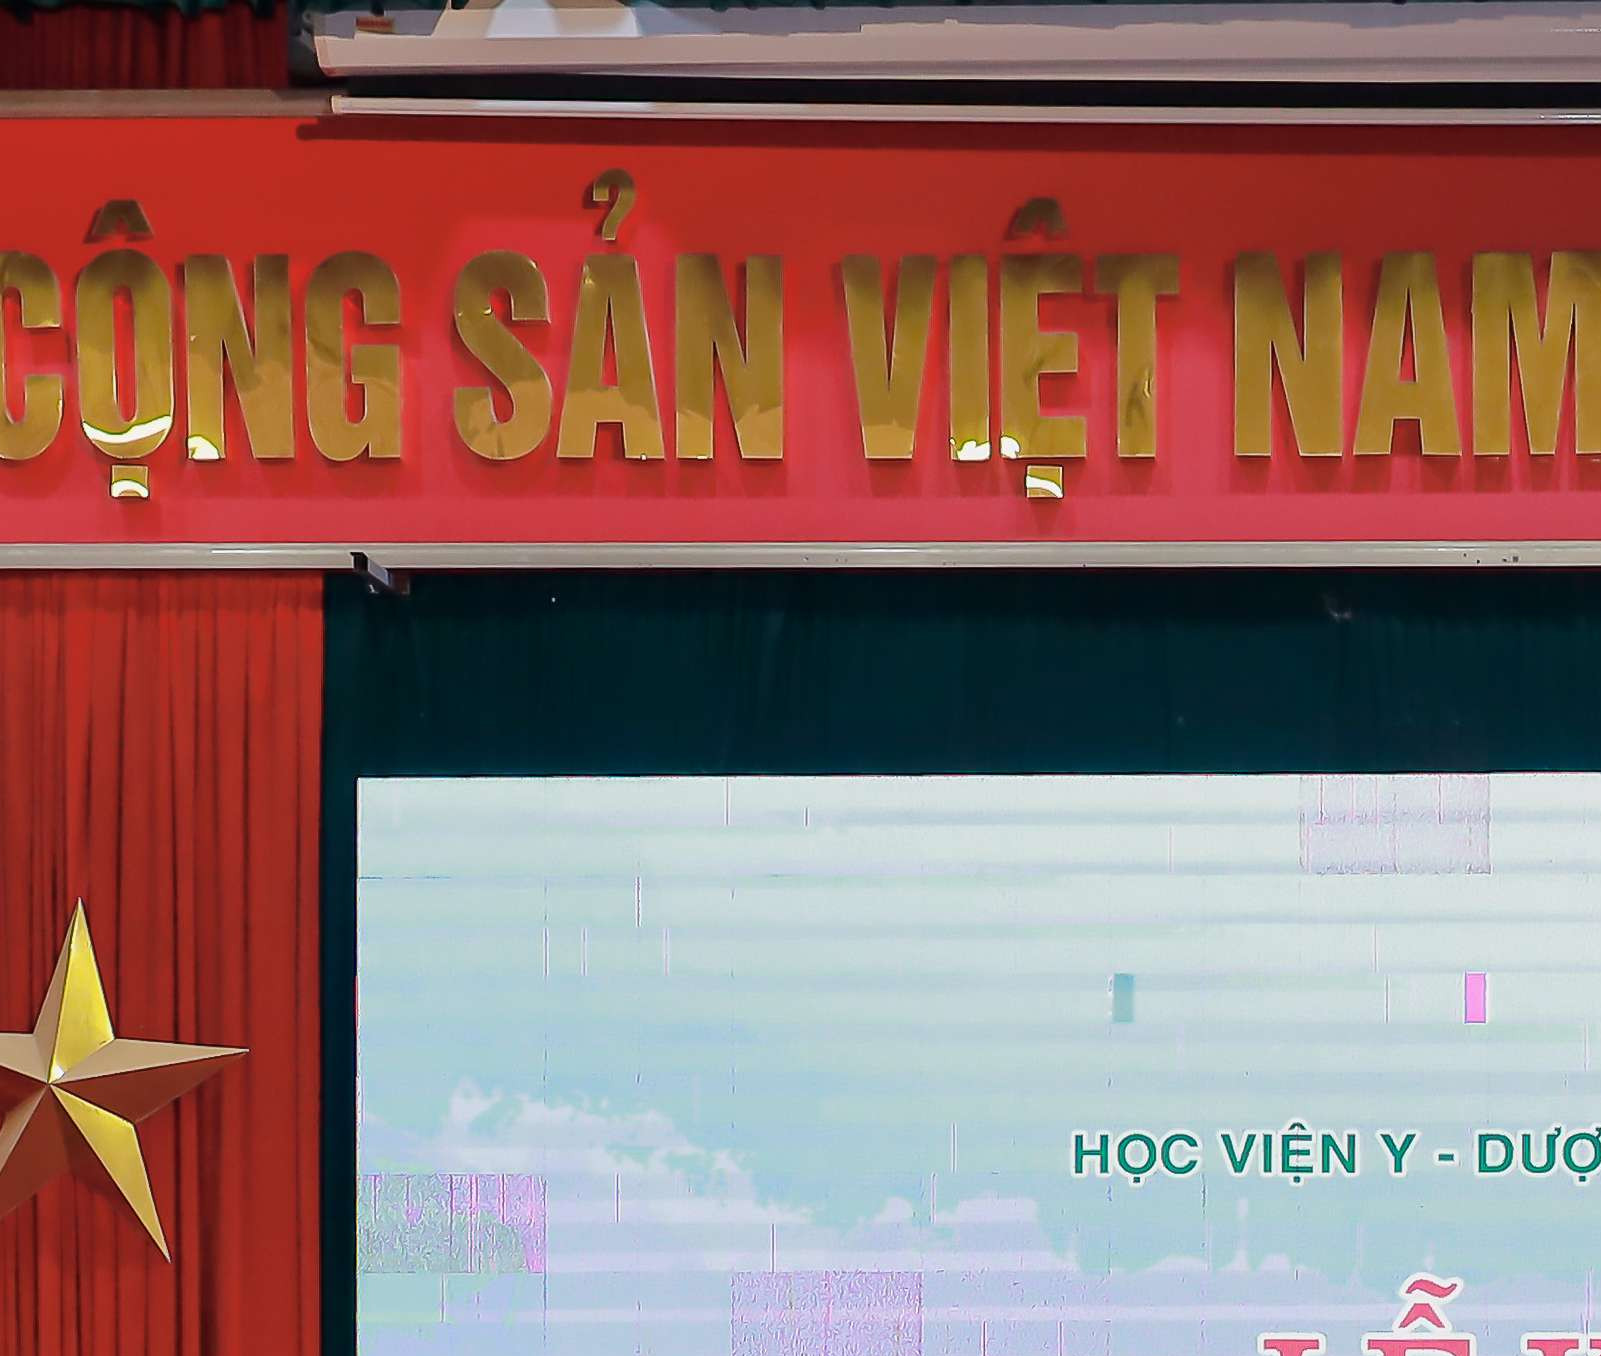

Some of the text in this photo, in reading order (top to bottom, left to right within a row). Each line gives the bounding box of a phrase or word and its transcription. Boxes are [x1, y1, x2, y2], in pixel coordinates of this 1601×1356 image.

[454, 166, 784, 461] SẢN
[843, 195, 1180, 498] VIỆT
[1074, 1132, 1199, 1184] HỌC
[1220, 1119, 1357, 1184] VIỆN
[1380, 1133, 1416, 1174] Y
